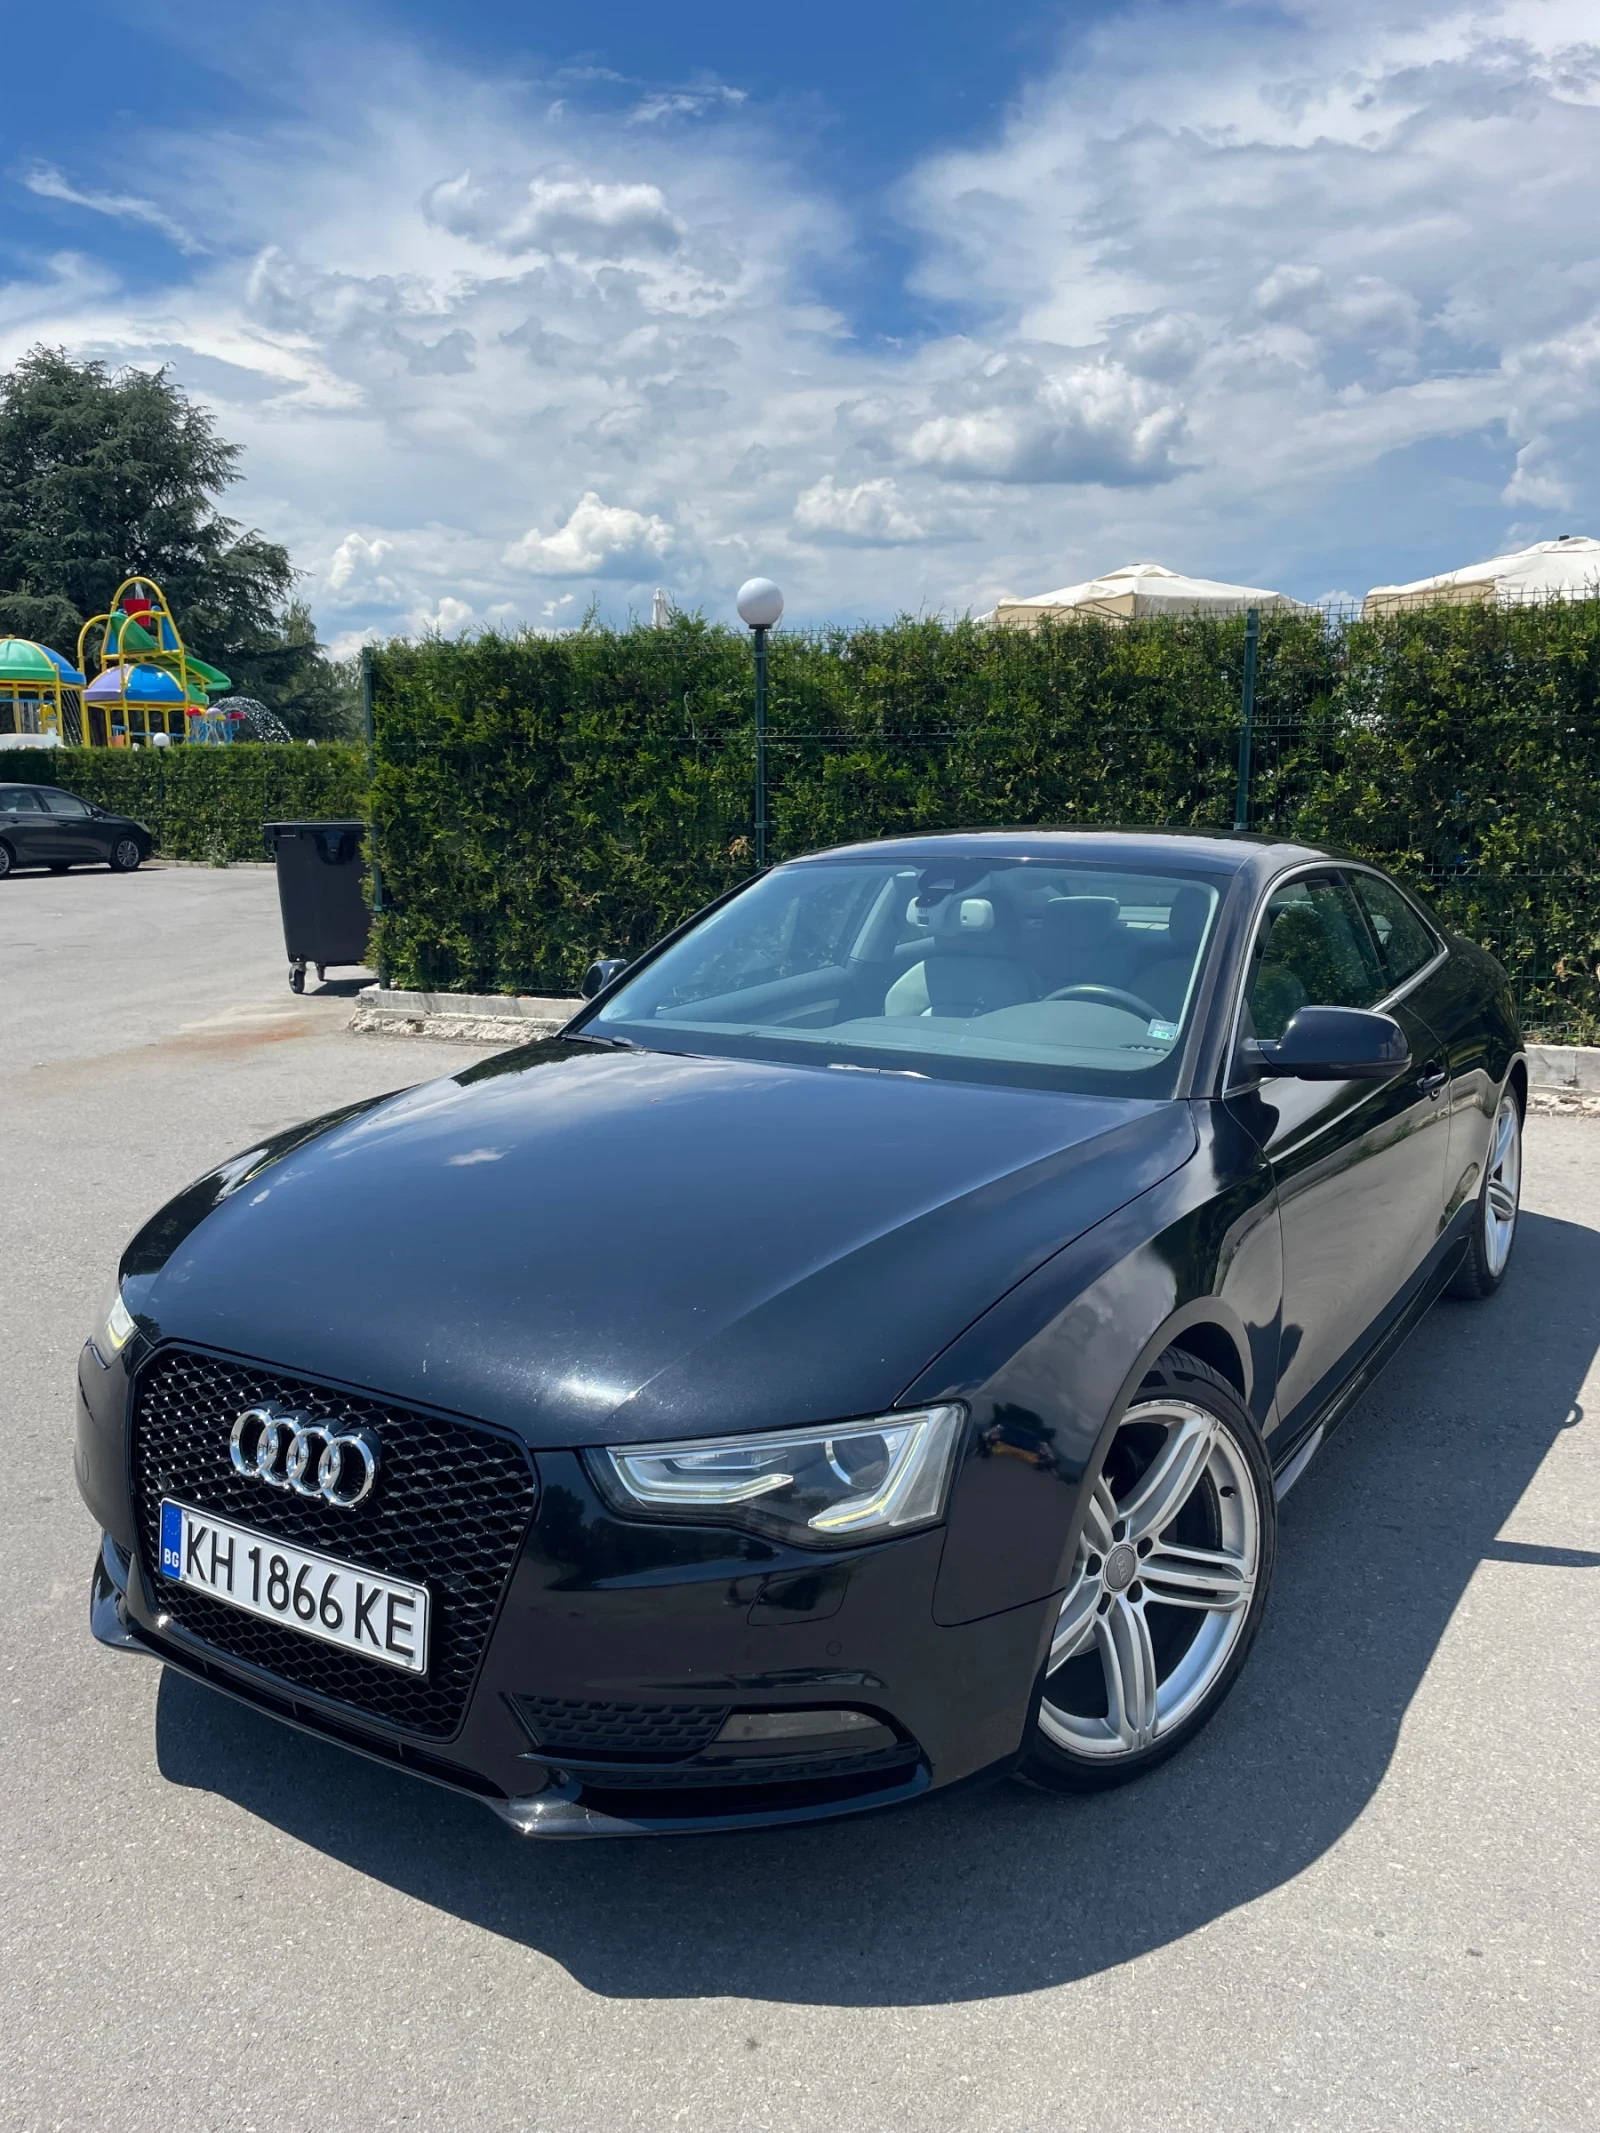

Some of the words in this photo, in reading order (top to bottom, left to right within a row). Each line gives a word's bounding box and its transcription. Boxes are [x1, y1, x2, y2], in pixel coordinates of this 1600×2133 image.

[164, 1548, 180, 1568] BG
[186, 1520, 236, 1592] KH
[248, 1546, 343, 1630] 1866
[354, 1581, 415, 1658] KE
